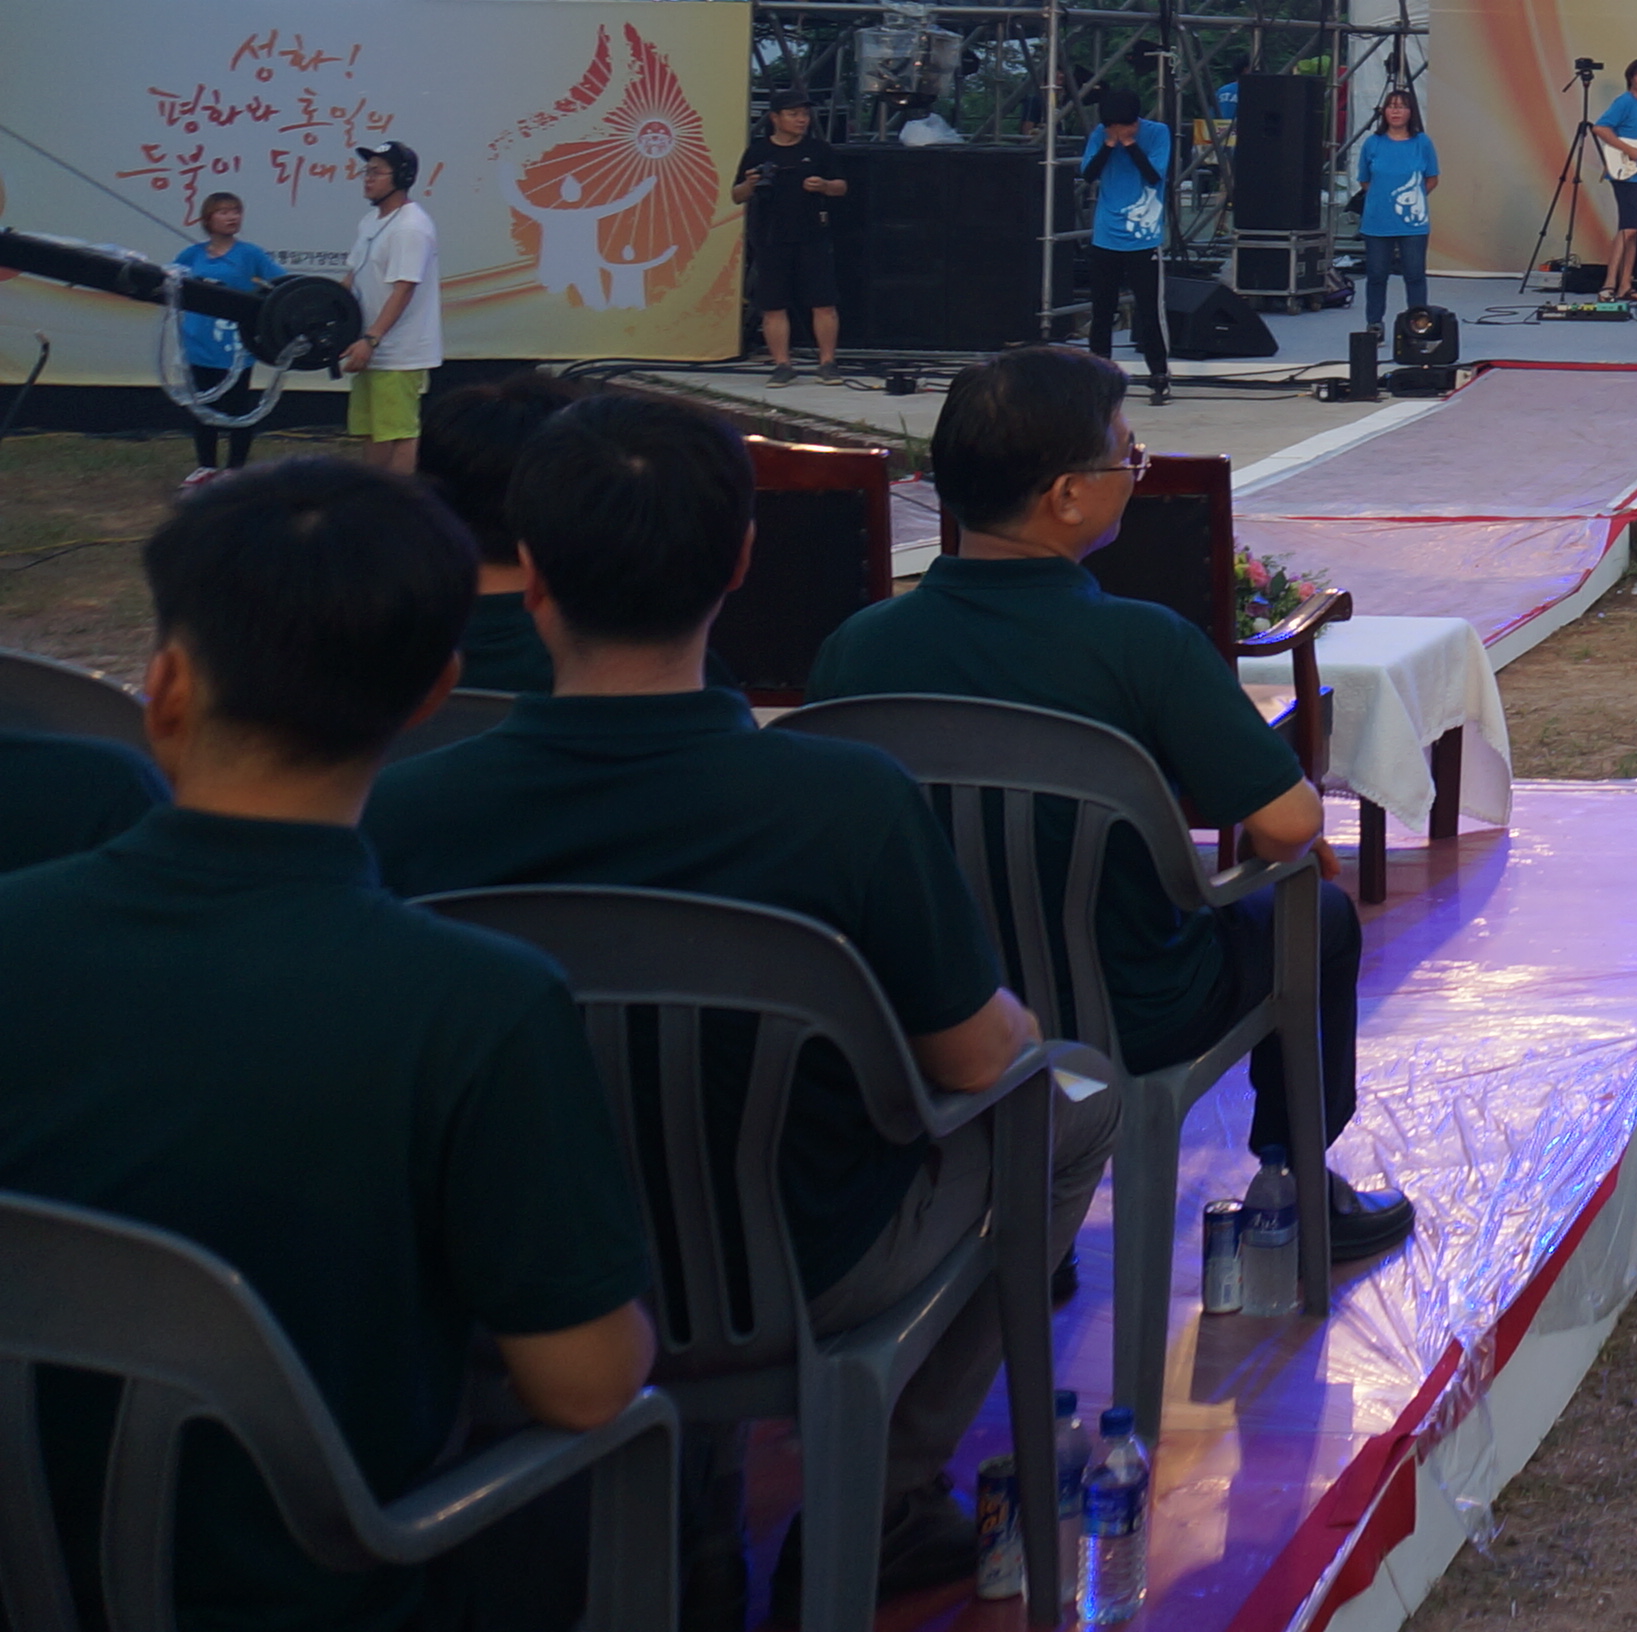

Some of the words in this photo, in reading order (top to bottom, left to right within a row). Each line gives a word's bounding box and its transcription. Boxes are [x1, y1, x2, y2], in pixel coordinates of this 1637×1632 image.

[230, 28, 362, 82] 성화!
[147, 83, 281, 135] 평화와
[277, 86, 395, 150] 통일의
[115, 143, 242, 228] 등불이
